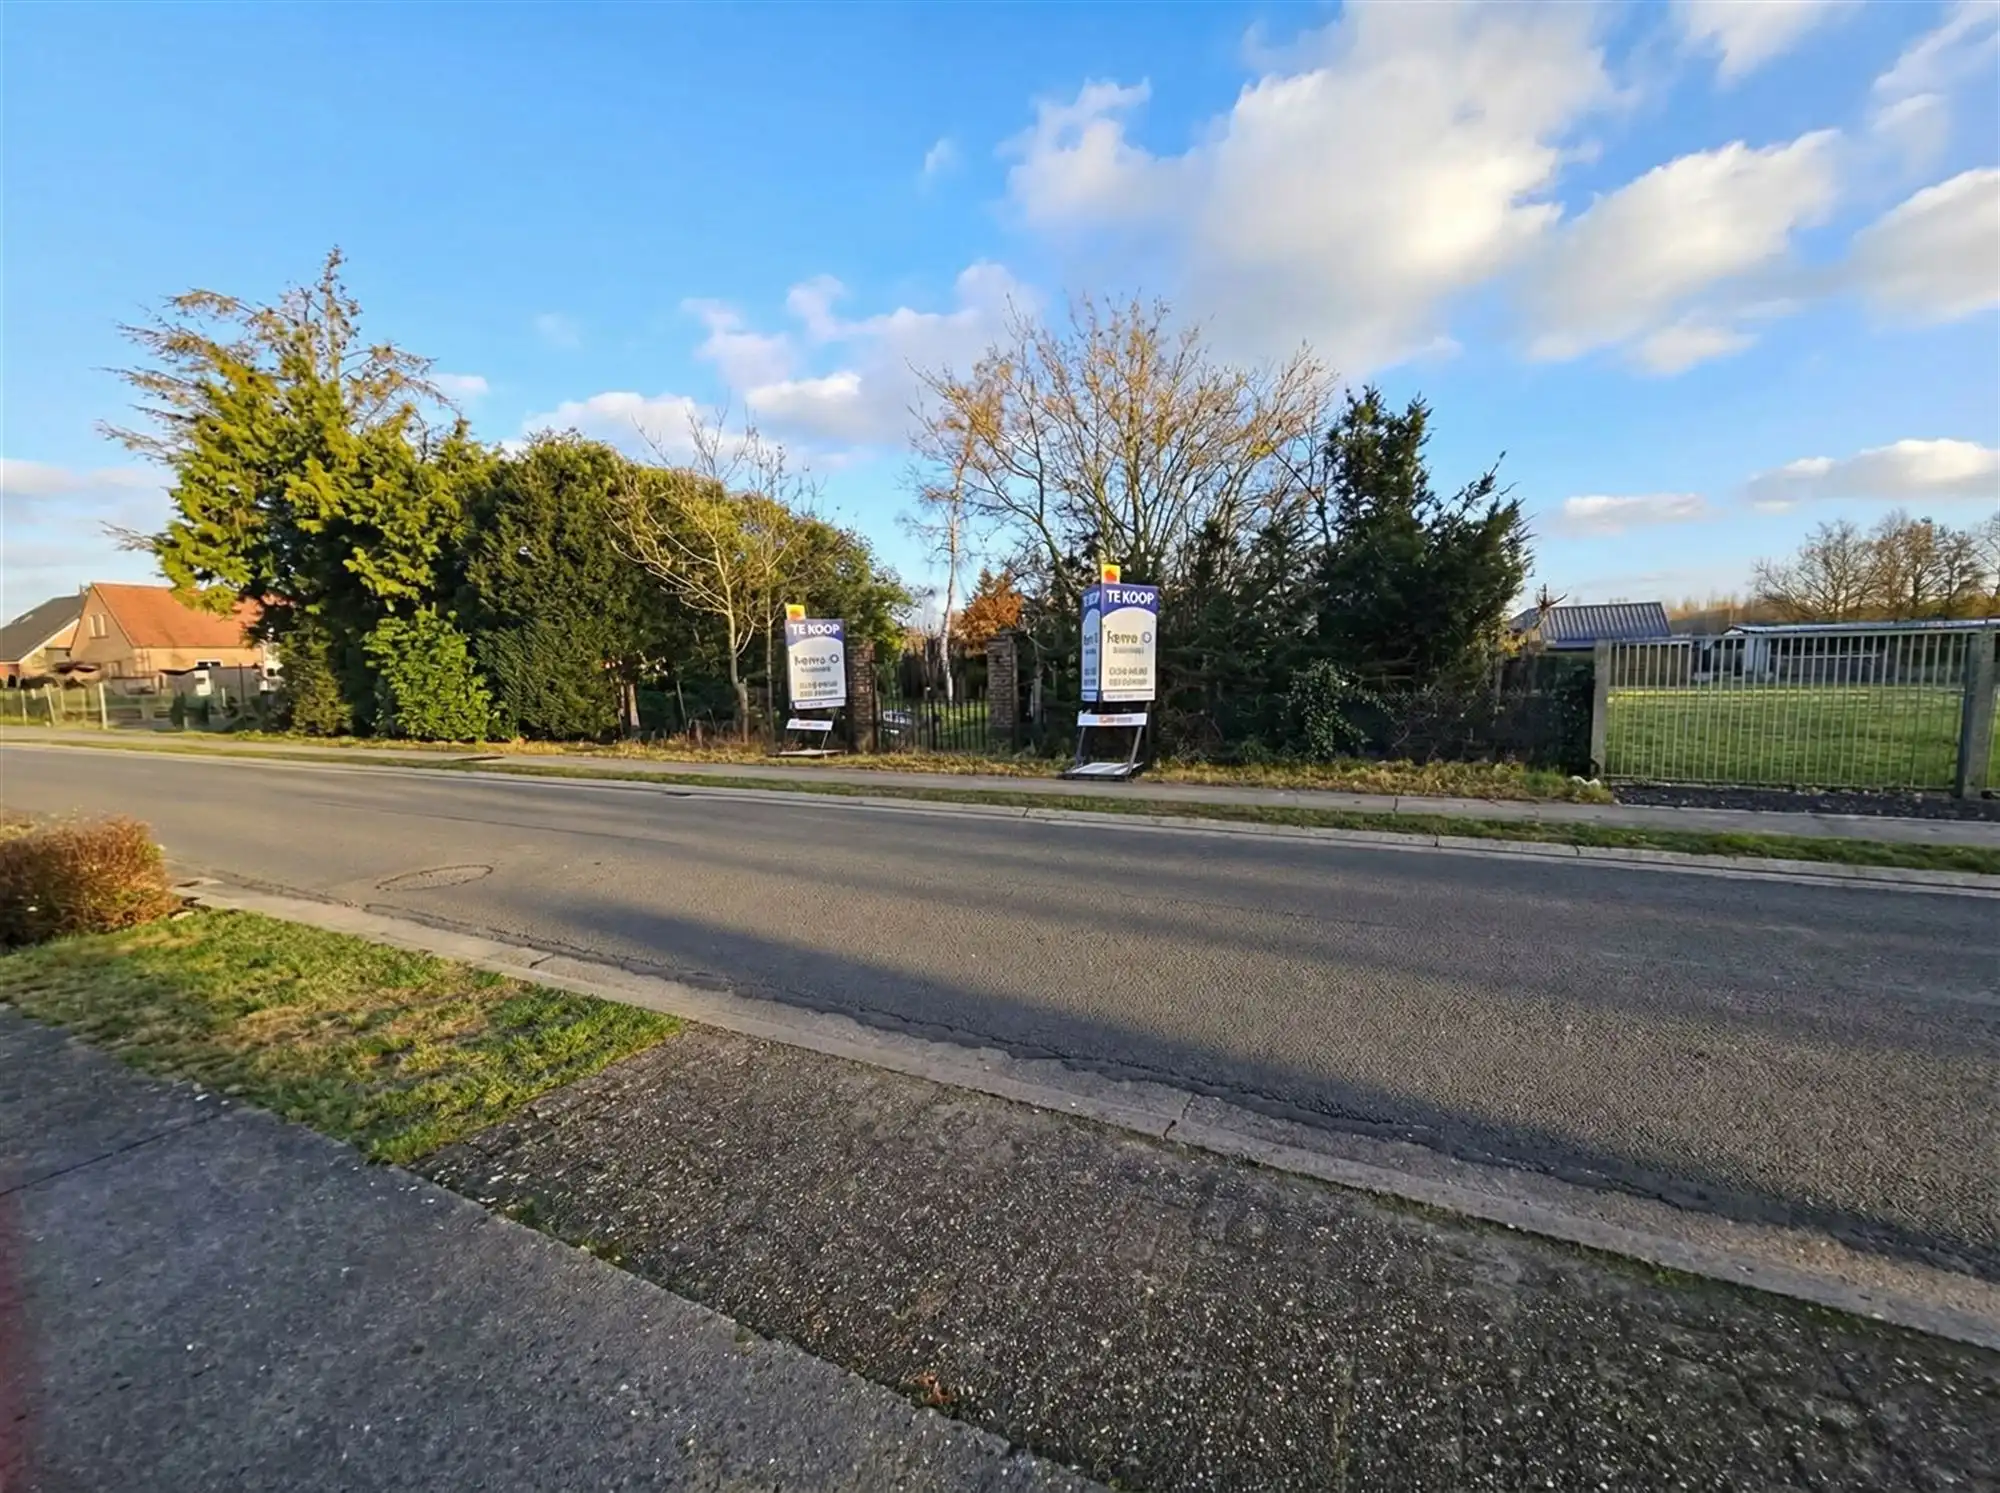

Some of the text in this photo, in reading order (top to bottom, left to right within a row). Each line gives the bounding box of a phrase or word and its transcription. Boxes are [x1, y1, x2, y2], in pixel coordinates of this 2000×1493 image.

[1106, 589, 1121, 604] TE
[1122, 590, 1155, 605] KOOP
[790, 623, 840, 636] TE KOOP
